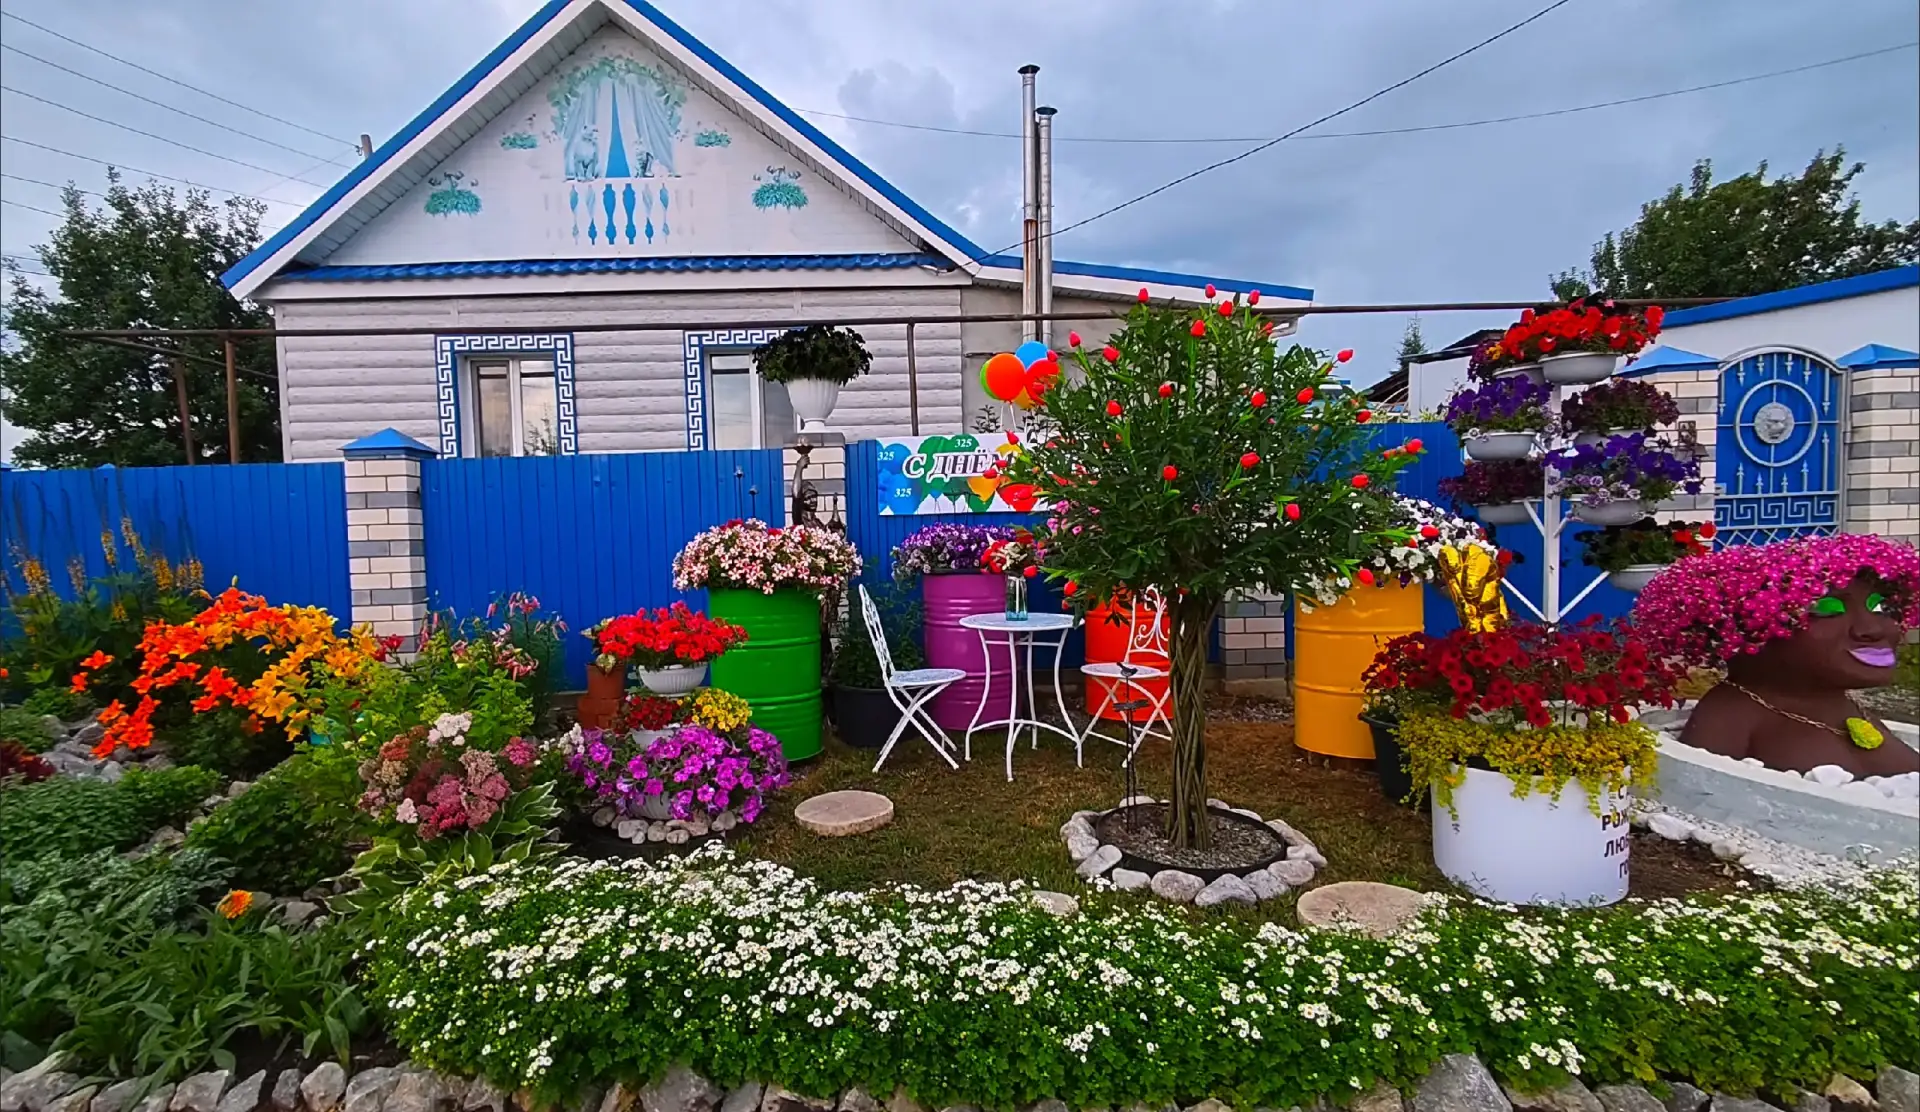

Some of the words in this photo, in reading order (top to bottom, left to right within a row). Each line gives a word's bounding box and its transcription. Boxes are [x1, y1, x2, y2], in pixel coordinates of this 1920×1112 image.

[955, 439, 972, 448] 325
[877, 451, 894, 460] 325
[903, 453, 926, 477] С
[894, 488, 912, 497] 325
